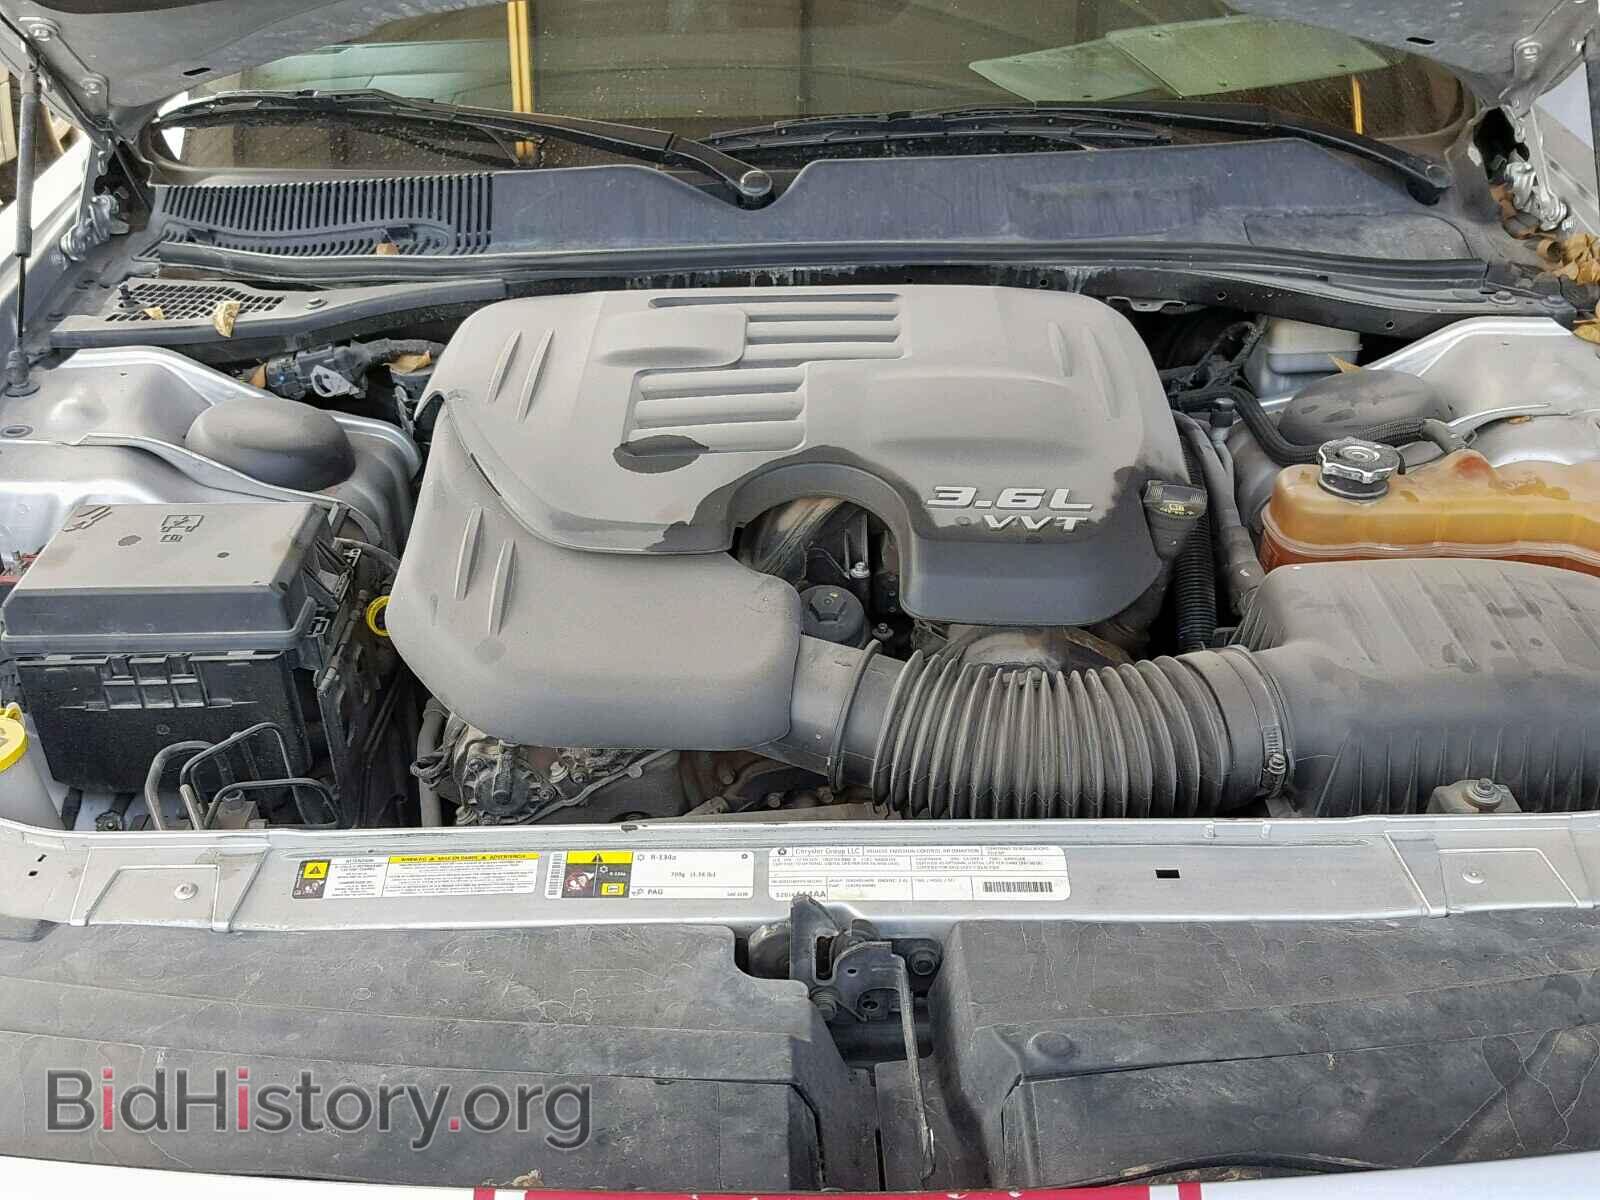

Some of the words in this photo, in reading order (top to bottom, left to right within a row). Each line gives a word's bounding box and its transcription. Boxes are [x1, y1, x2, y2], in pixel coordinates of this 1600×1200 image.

[927, 486, 1094, 512] 3.6L
[983, 514, 1089, 533] VVT
[825, 847, 846, 856] Group
[847, 847, 861, 855] LLC
